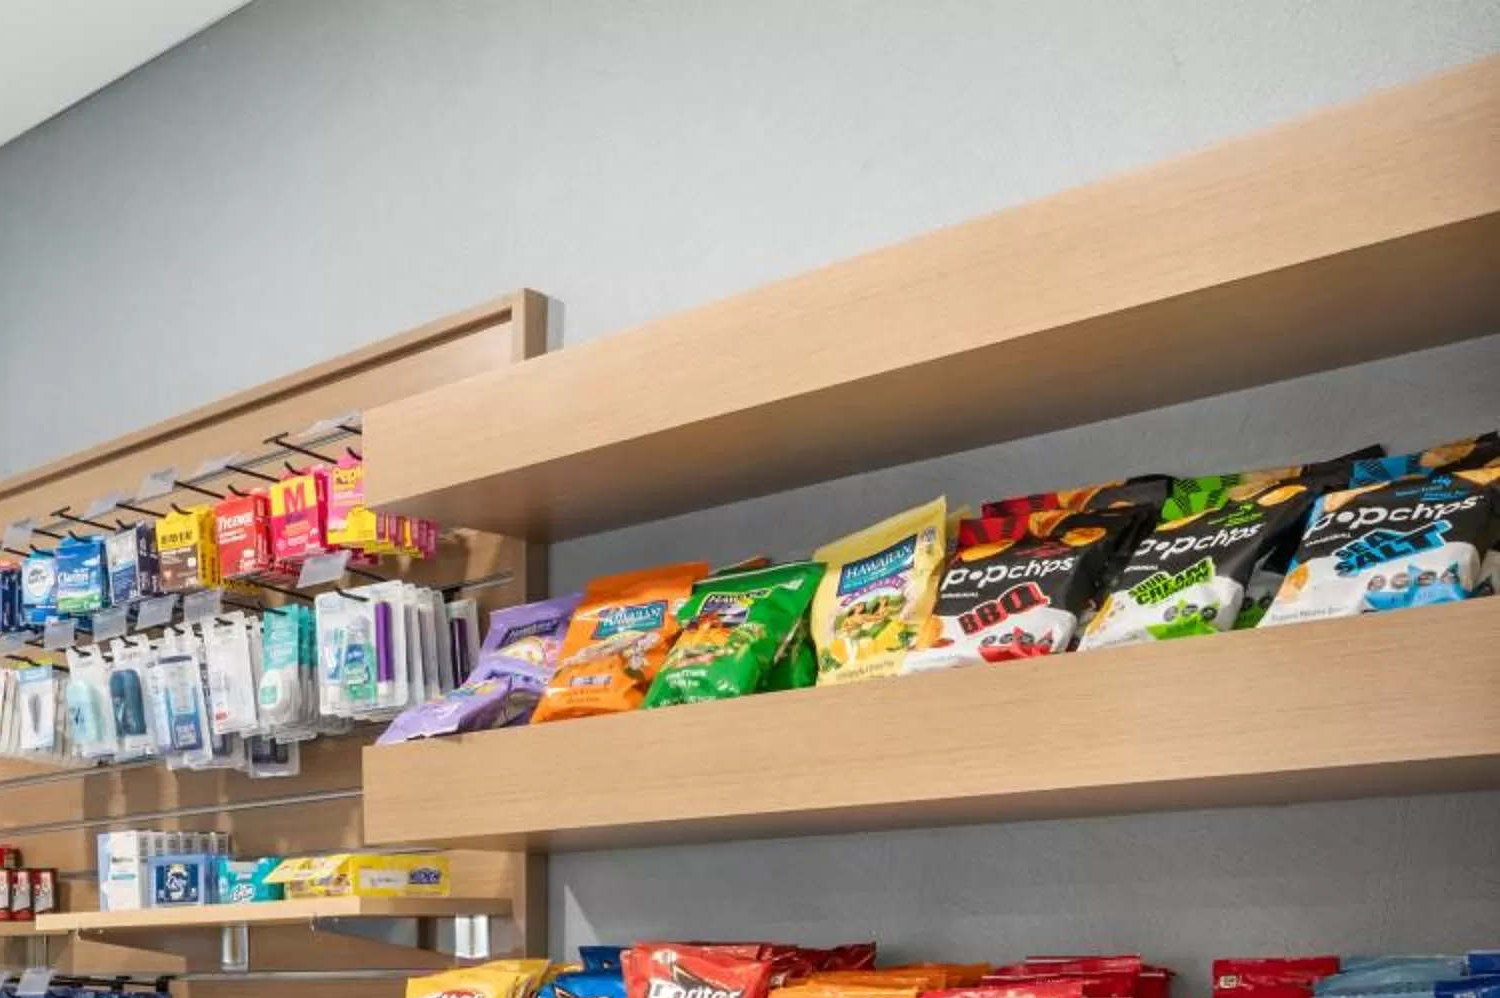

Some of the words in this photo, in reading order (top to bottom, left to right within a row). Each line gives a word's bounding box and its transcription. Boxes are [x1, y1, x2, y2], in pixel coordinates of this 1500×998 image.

[940, 557, 1075, 592] popchips
[1334, 520, 1453, 577] SALT
[957, 582, 1049, 635] BBQ
